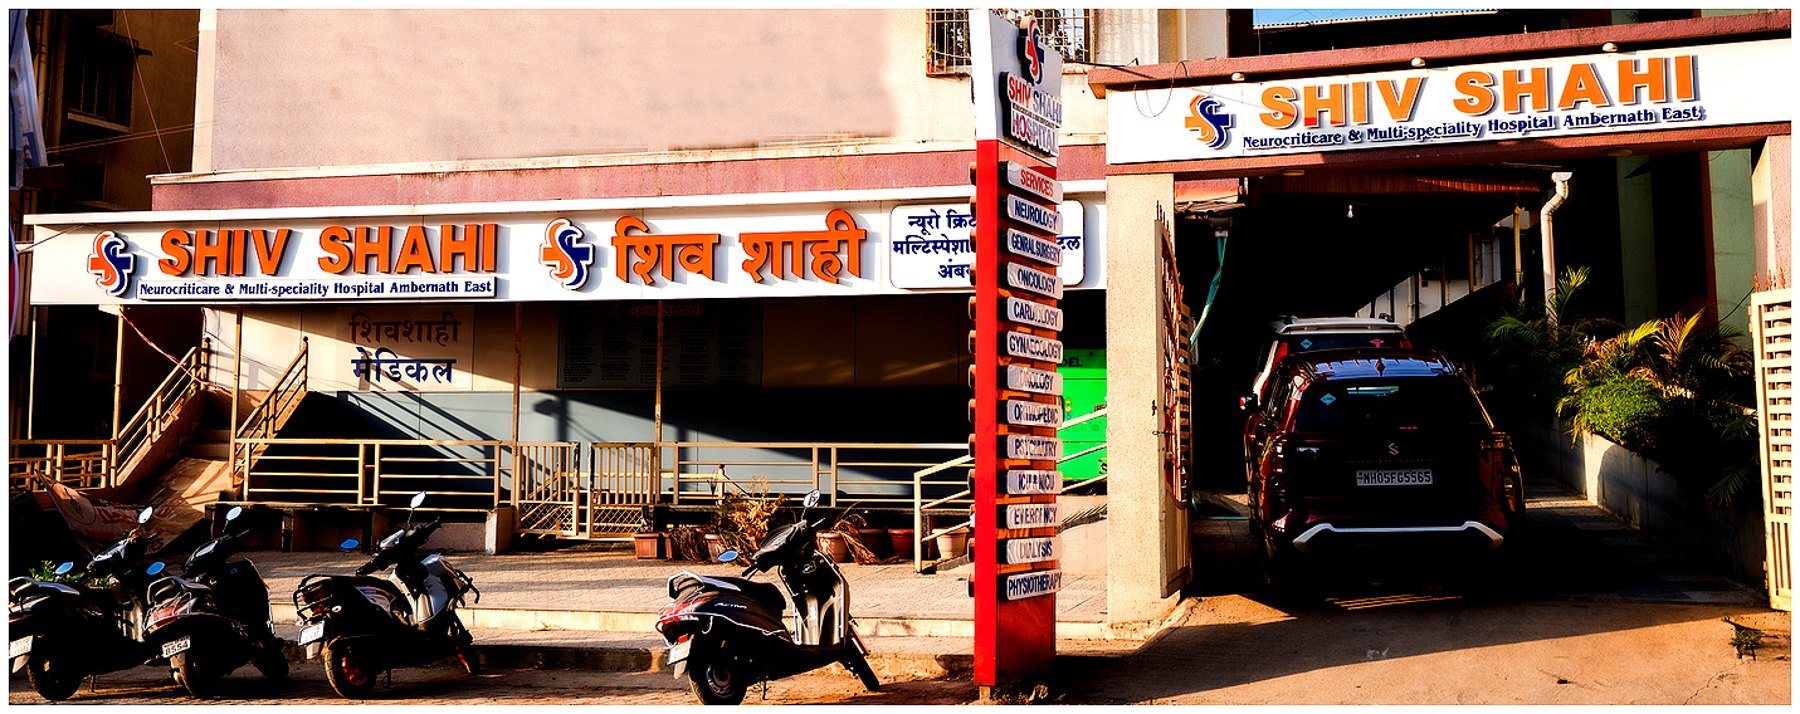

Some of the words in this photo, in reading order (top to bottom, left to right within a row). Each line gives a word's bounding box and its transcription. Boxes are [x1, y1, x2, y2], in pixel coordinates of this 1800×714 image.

[1008, 76, 1031, 109] SHIV
[1033, 90, 1062, 125] SHAHI
[1259, 77, 1422, 129] SHIV
[1453, 54, 1693, 116] SHAHI
[1012, 110, 1059, 154] HOSPITAL
[1243, 131, 1342, 148] Neurocriticare
[1350, 129, 1361, 142] &
[1367, 120, 1480, 142] Multi-speciality
[1488, 115, 1553, 132] Hospital
[1563, 109, 1655, 126] Ambernath
[1020, 169, 1054, 198] SERVICES
[908, 209, 941, 236] न्यूरो
[1015, 199, 1058, 230] NEUROLOGY
[159, 228, 293, 277] SHIV
[318, 223, 498, 275] SHAHI
[611, 216, 721, 286] शिव
[739, 209, 867, 284] शाही
[140, 282, 220, 296] Neurocriticare
[224, 283, 235, 295] &
[239, 282, 330, 298] Multi-speciality
[334, 281, 384, 297] Hospital
[390, 280, 459, 294] Ambernath
[464, 280, 492, 293] East
[1018, 268, 1056, 294] ONCOLOGY
[349, 310, 461, 347] शिवशाही
[1014, 301, 1059, 327] CARDLOGY
[351, 347, 457, 383] मेडिकल
[1008, 571, 1062, 597] PHYSIOTHERAPY
